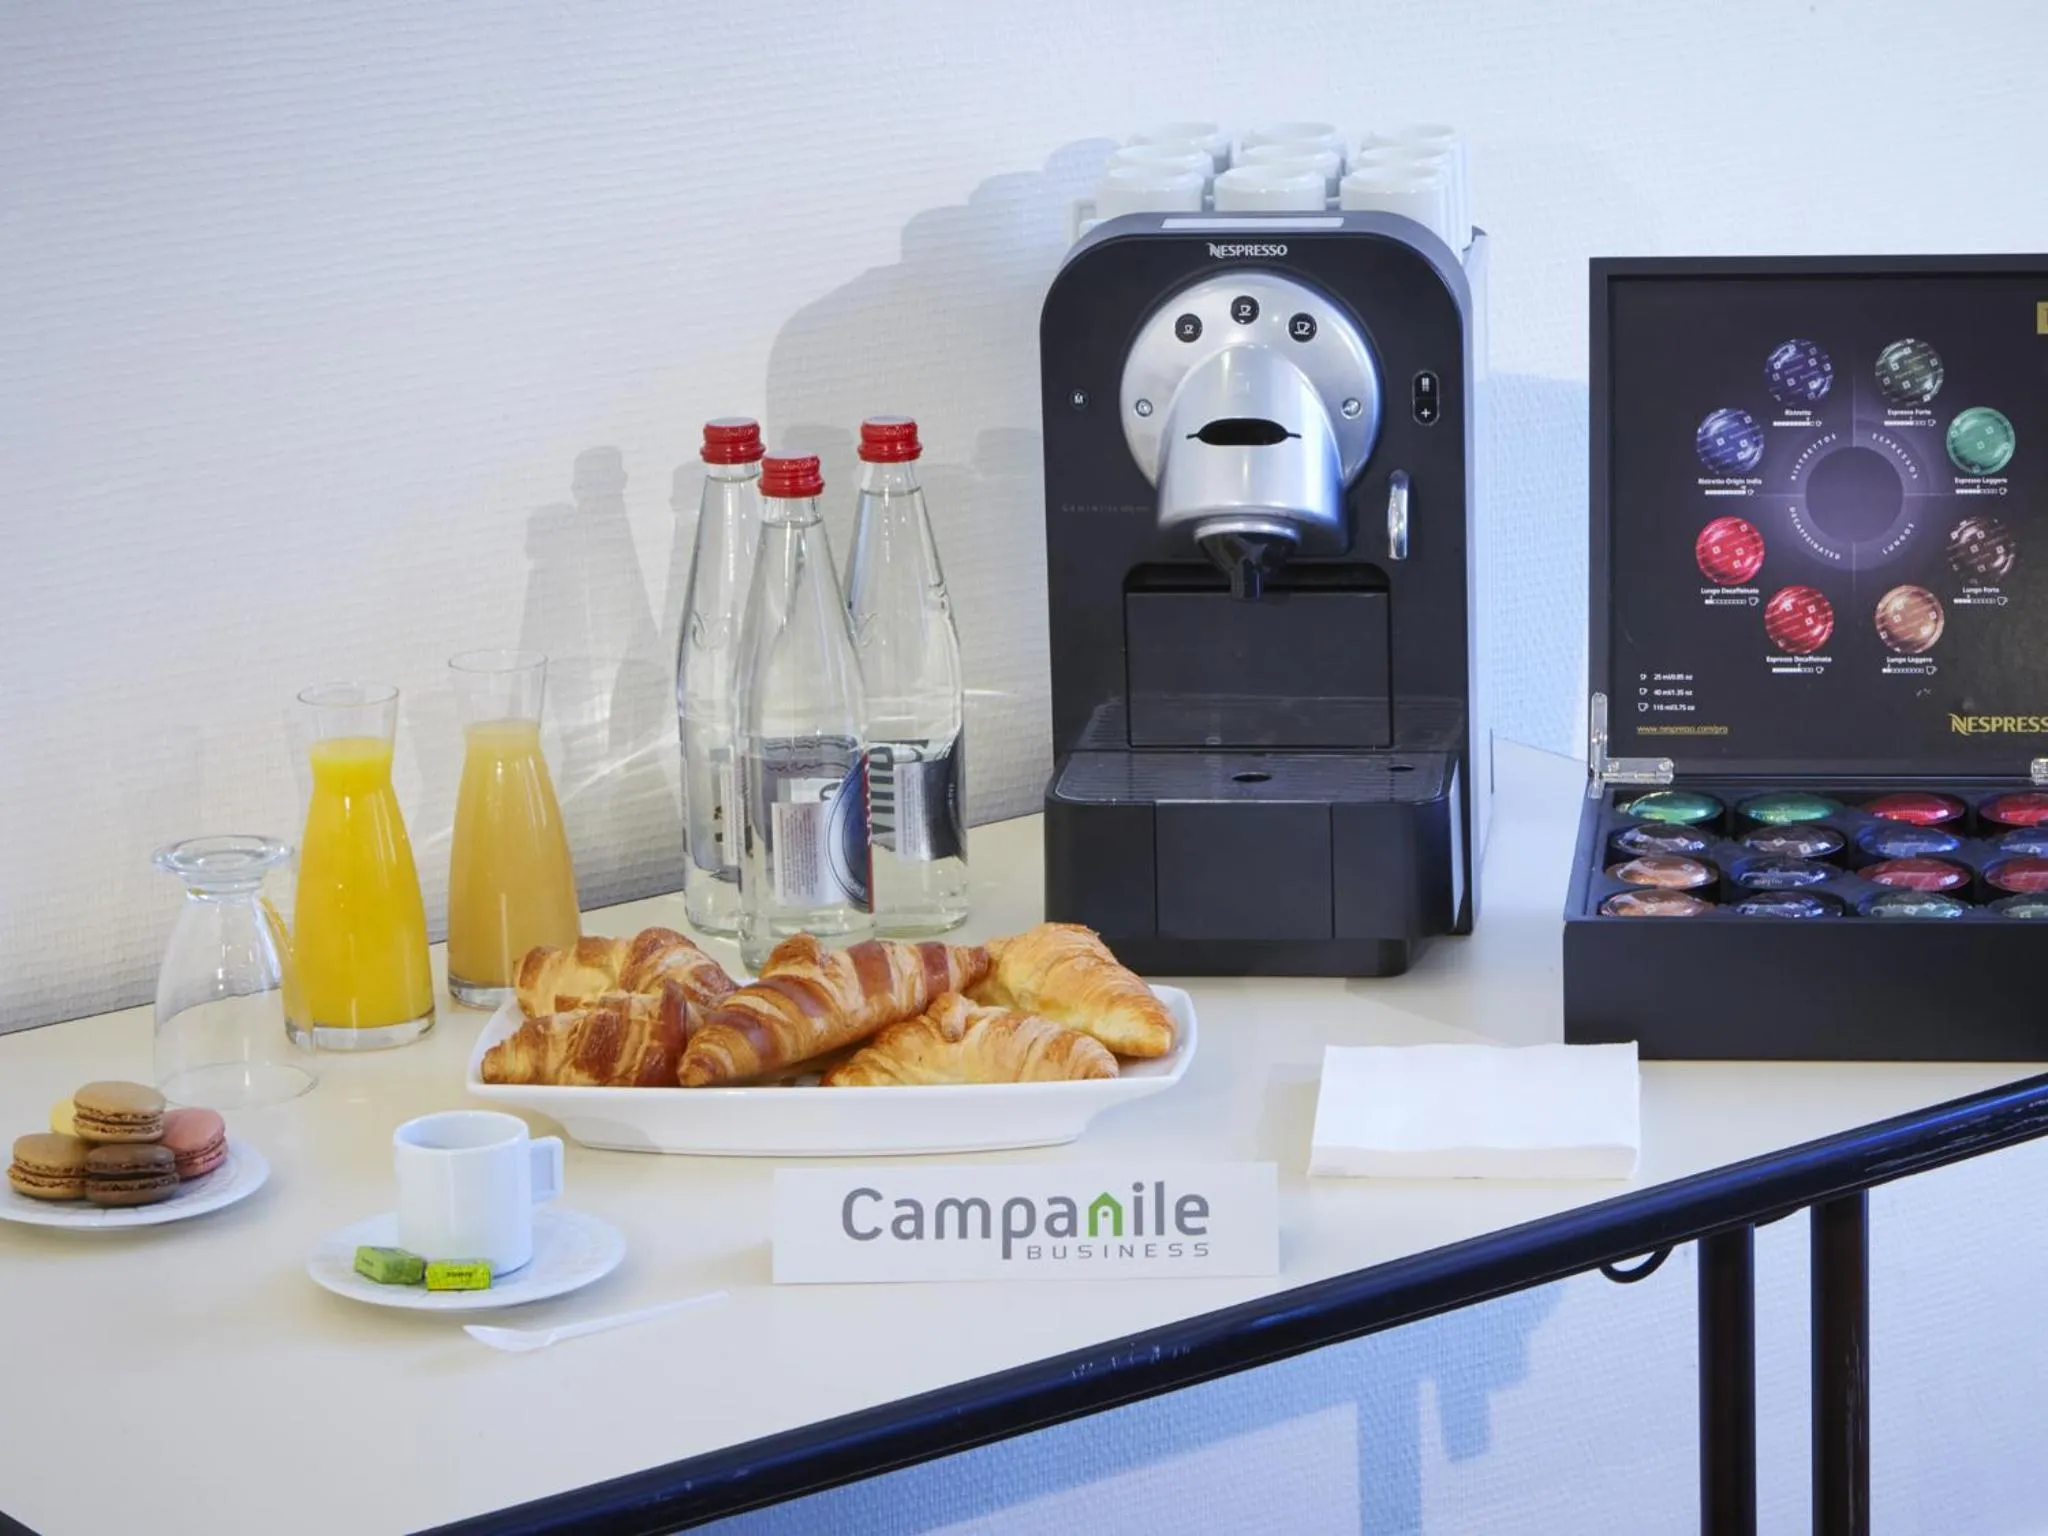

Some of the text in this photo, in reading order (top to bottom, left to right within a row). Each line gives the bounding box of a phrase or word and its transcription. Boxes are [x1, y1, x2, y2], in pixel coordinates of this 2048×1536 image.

[1206, 242, 1288, 258] NESPRESSO
[842, 1181, 1210, 1260] Campanile
[1027, 1242, 1210, 1260] BUSINESS
